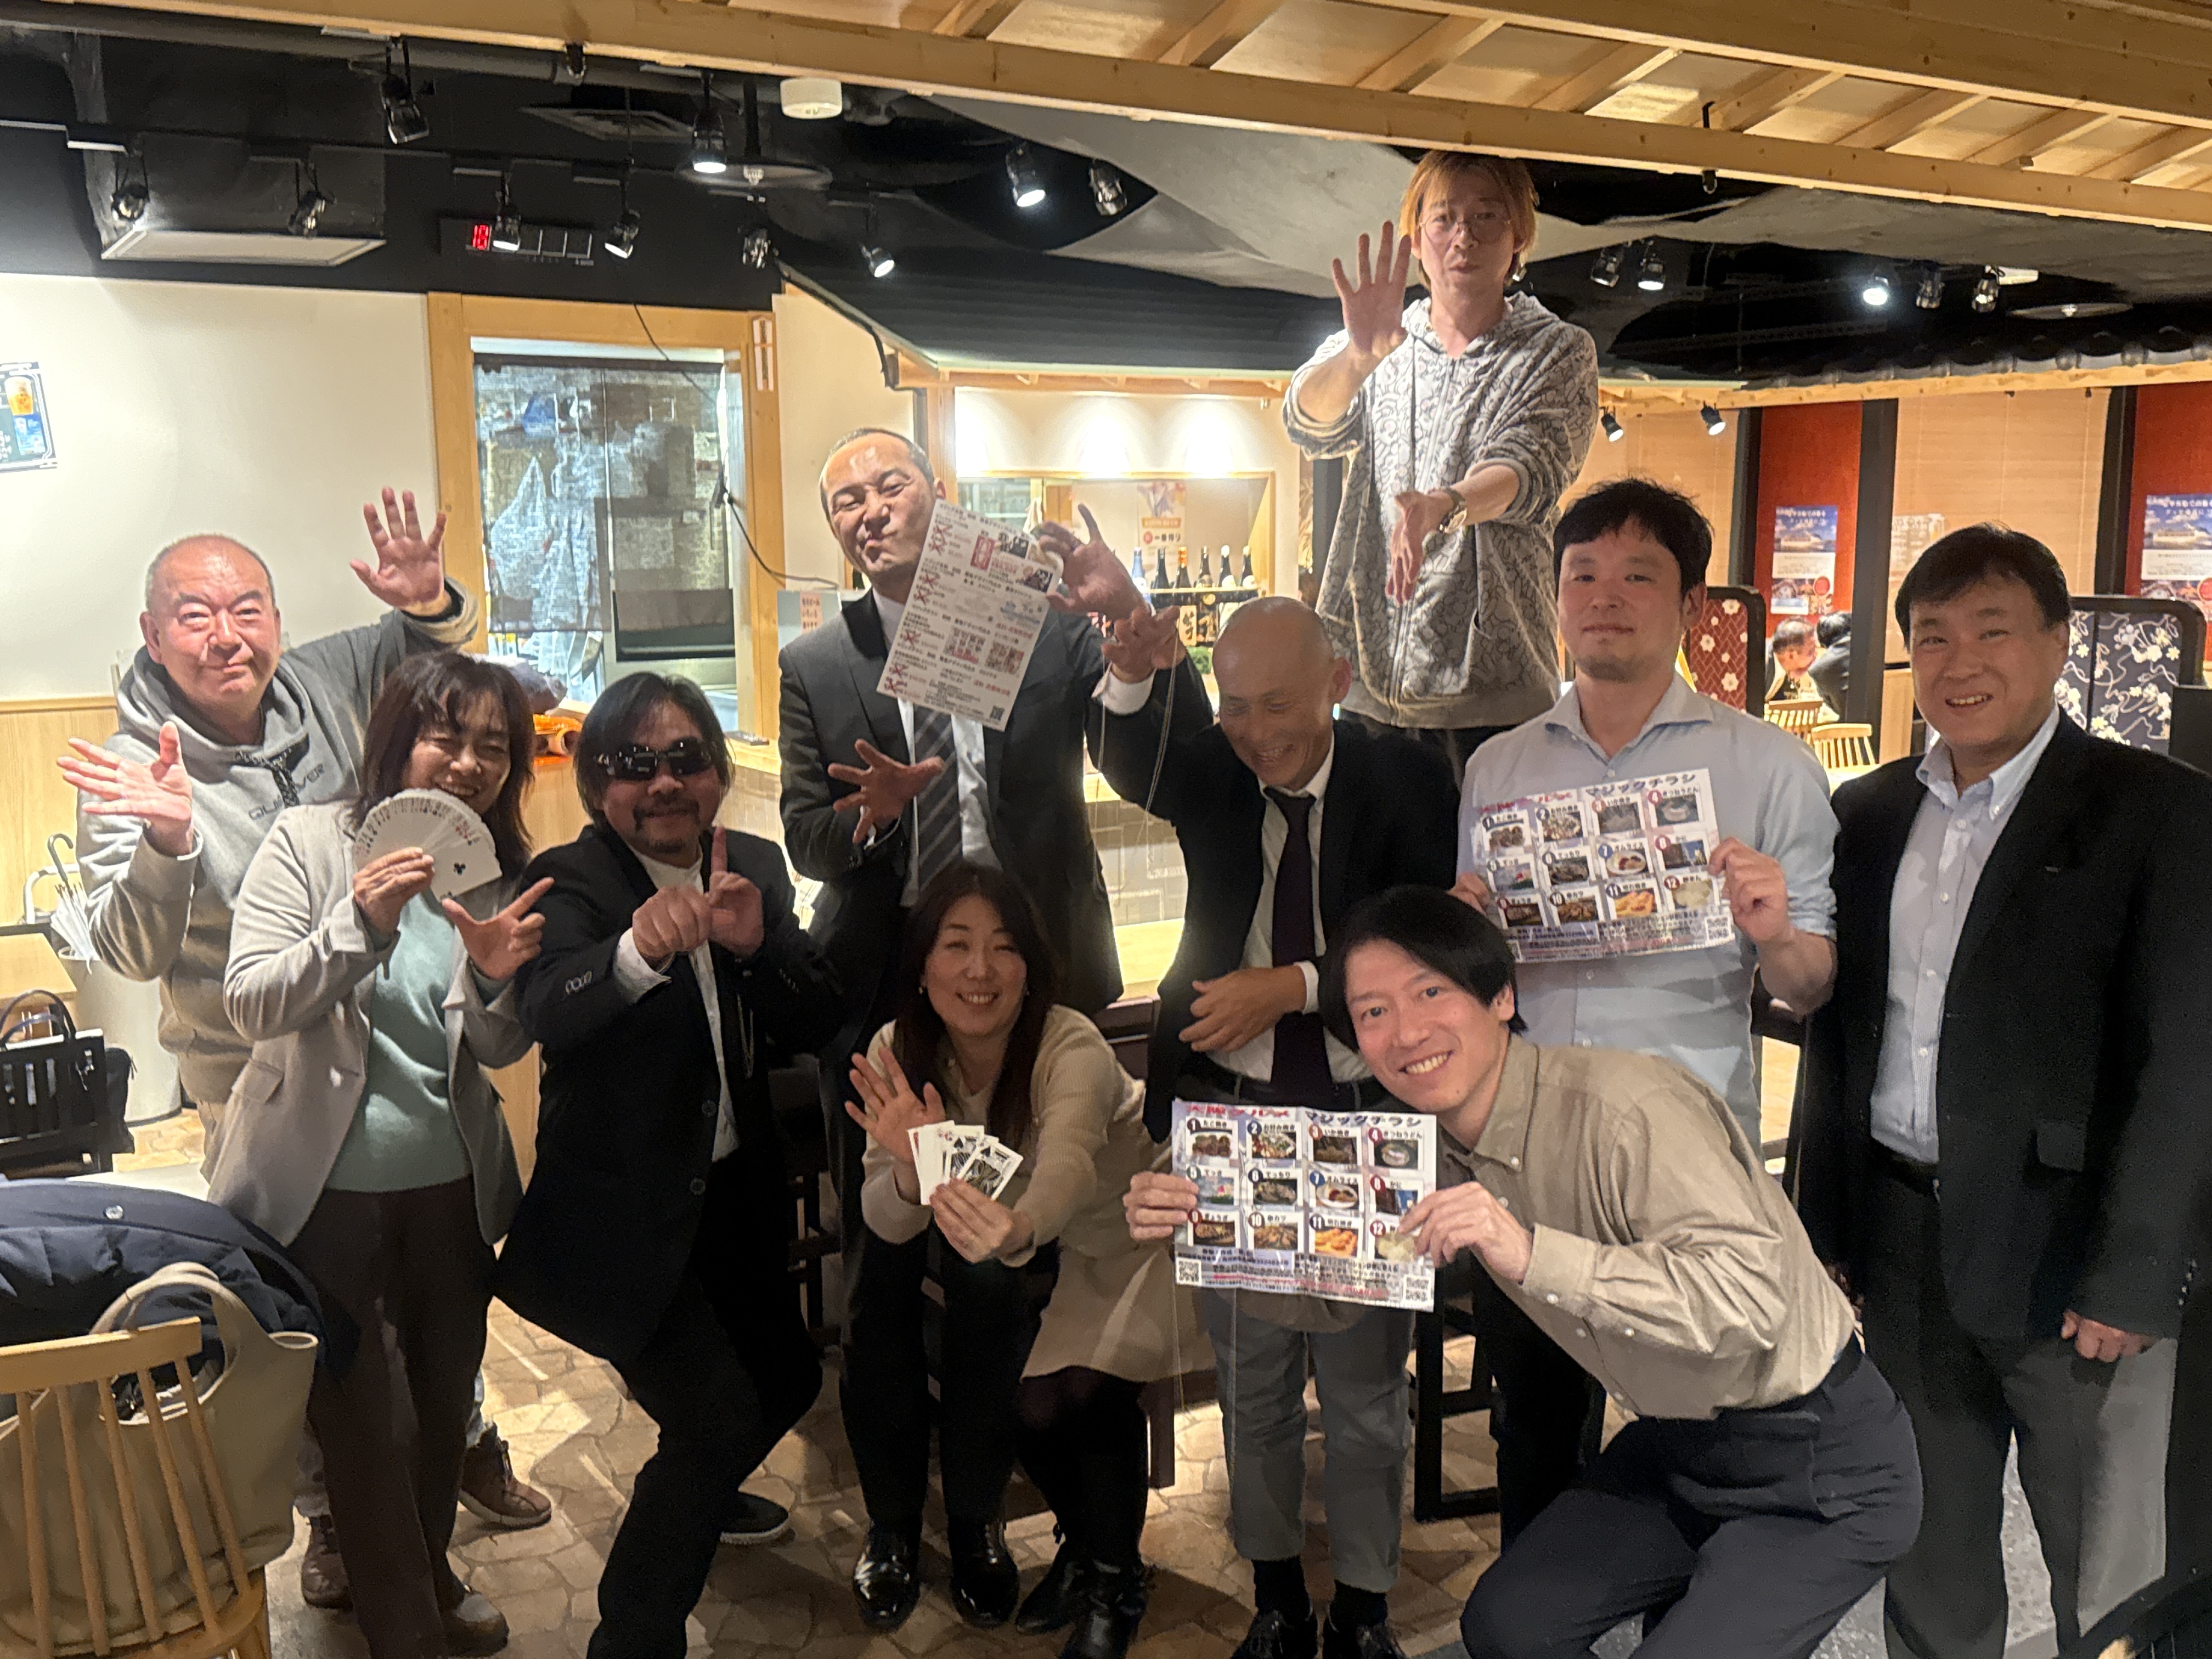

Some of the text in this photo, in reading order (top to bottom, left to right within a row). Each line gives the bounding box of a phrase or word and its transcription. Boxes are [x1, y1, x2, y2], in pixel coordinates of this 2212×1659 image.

[1585, 774, 1696, 795] マジックチラシ
[1652, 792, 1658, 803] 4
[1539, 809, 1546, 821] 2
[1486, 817, 1491, 828] 1
[1602, 845, 1609, 857] 7
[1666, 878, 1677, 889] 12
[1609, 885, 1619, 898] 11
[1551, 893, 1563, 905] 10
[1305, 1110, 1422, 1127] マジックチラシ
[1191, 1119, 1196, 1131] 1
[1251, 1122, 1257, 1134] 2
[1373, 1129, 1379, 1141] 4
[1314, 1172, 1320, 1184] 7
[1251, 1213, 1261, 1227] 10
[1312, 1216, 1322, 1228] 11
[1372, 1222, 1384, 1235] 12
